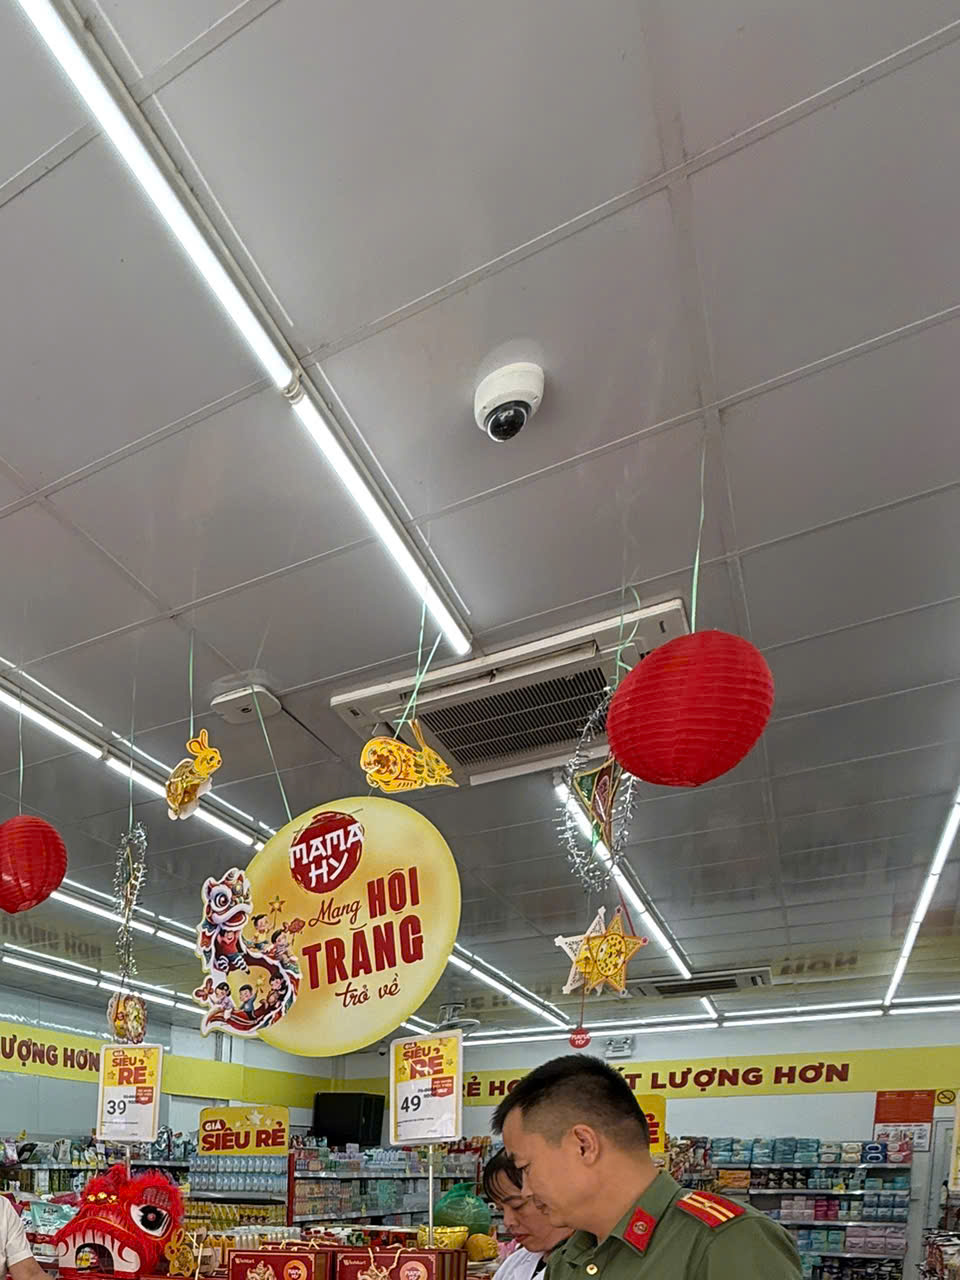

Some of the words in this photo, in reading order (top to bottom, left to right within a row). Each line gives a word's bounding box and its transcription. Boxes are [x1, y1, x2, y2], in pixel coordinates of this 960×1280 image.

[290, 821, 366, 869] MAMA
[309, 852, 348, 887] HY
[308, 897, 361, 927] Mang
[367, 866, 420, 920] HỘI
[302, 915, 424, 990] TRĂNG
[335, 981, 370, 1008] trở
[378, 972, 401, 998] về
[64, 1046, 100, 1071] HƠN
[403, 1046, 431, 1061] SIÊU
[410, 1048, 444, 1079] RẺ
[651, 1067, 763, 1091] LƯỢNG
[774, 1062, 849, 1085] HƠN
[107, 1100, 126, 1115] 39
[401, 1095, 421, 1112] 49
[202, 1127, 250, 1151] SIÊU
[256, 1121, 286, 1147] RẺ
[205, 1119, 221, 1131] GIÁ
